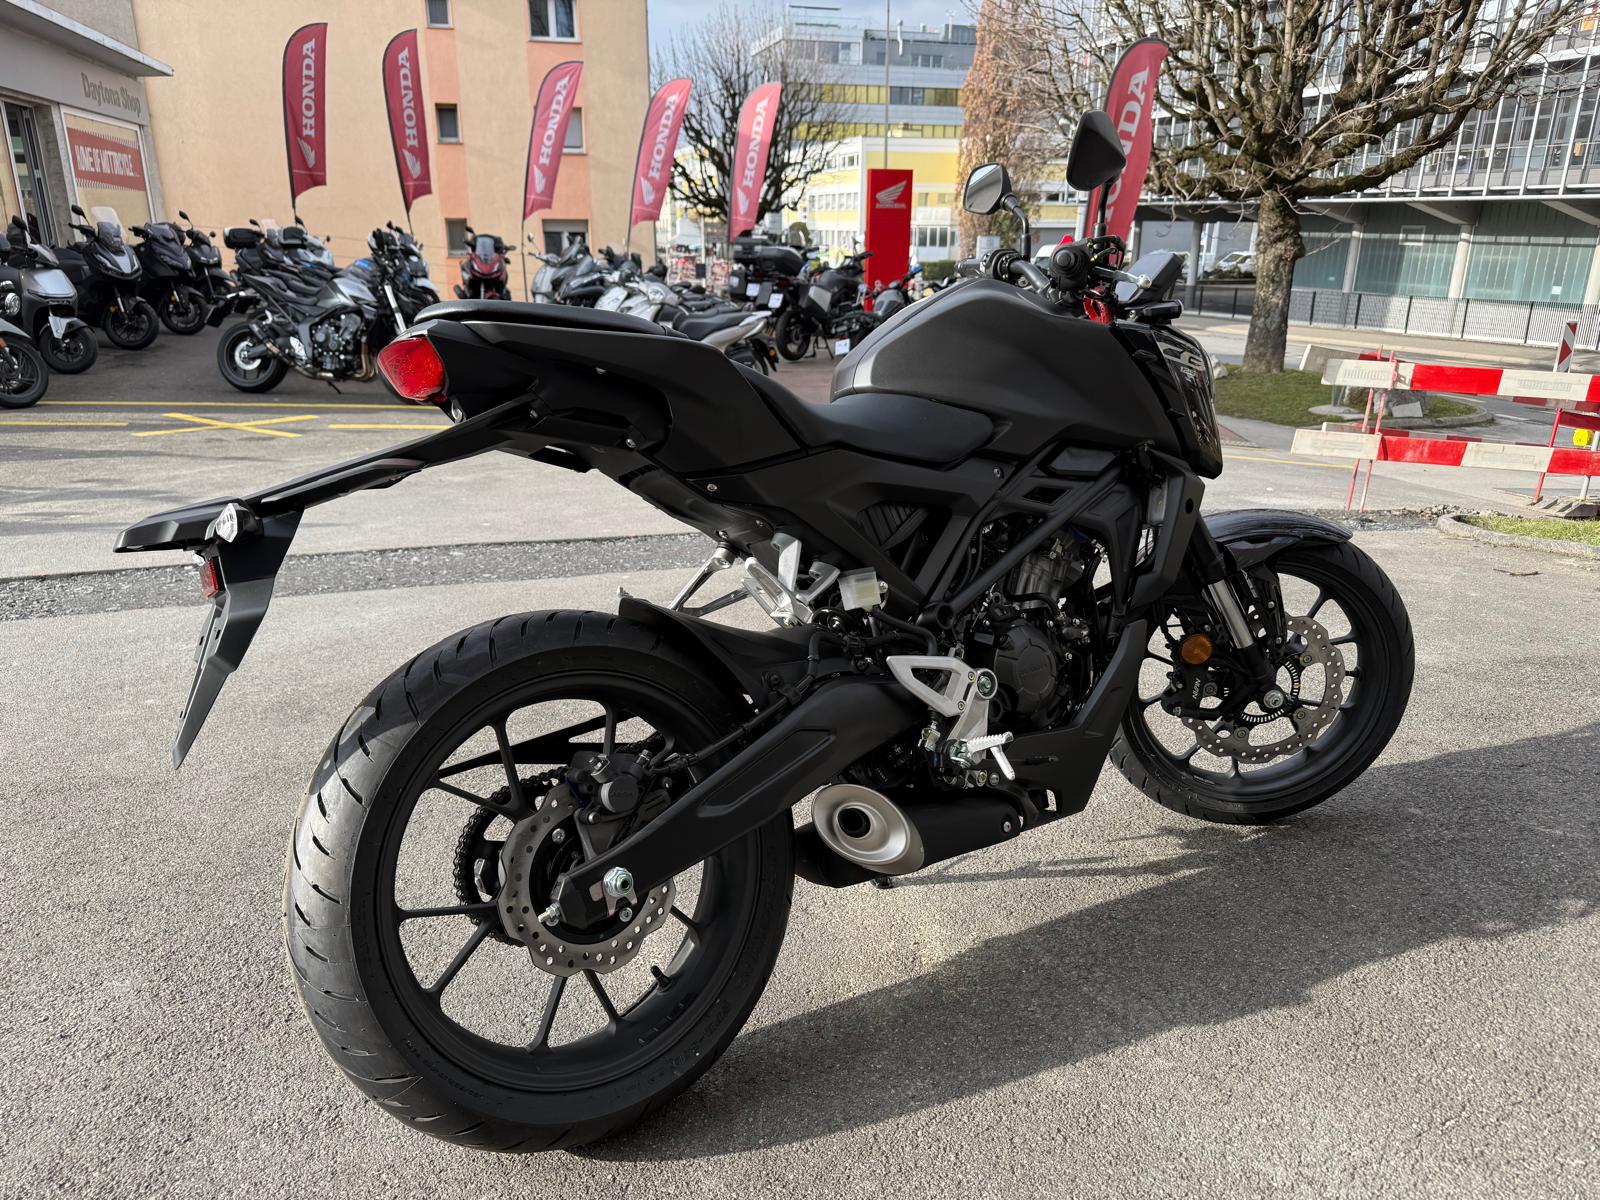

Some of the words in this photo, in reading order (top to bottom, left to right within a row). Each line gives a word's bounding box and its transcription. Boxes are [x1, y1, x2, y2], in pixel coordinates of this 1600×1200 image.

[81, 71, 121, 107] Daytona
[120, 86, 141, 118] Shop
[302, 38, 315, 138] HONDA
[398, 46, 419, 148] HONDA
[539, 75, 570, 167] HONDA
[648, 92, 680, 181] HONDA
[743, 98, 769, 189] HONDA
